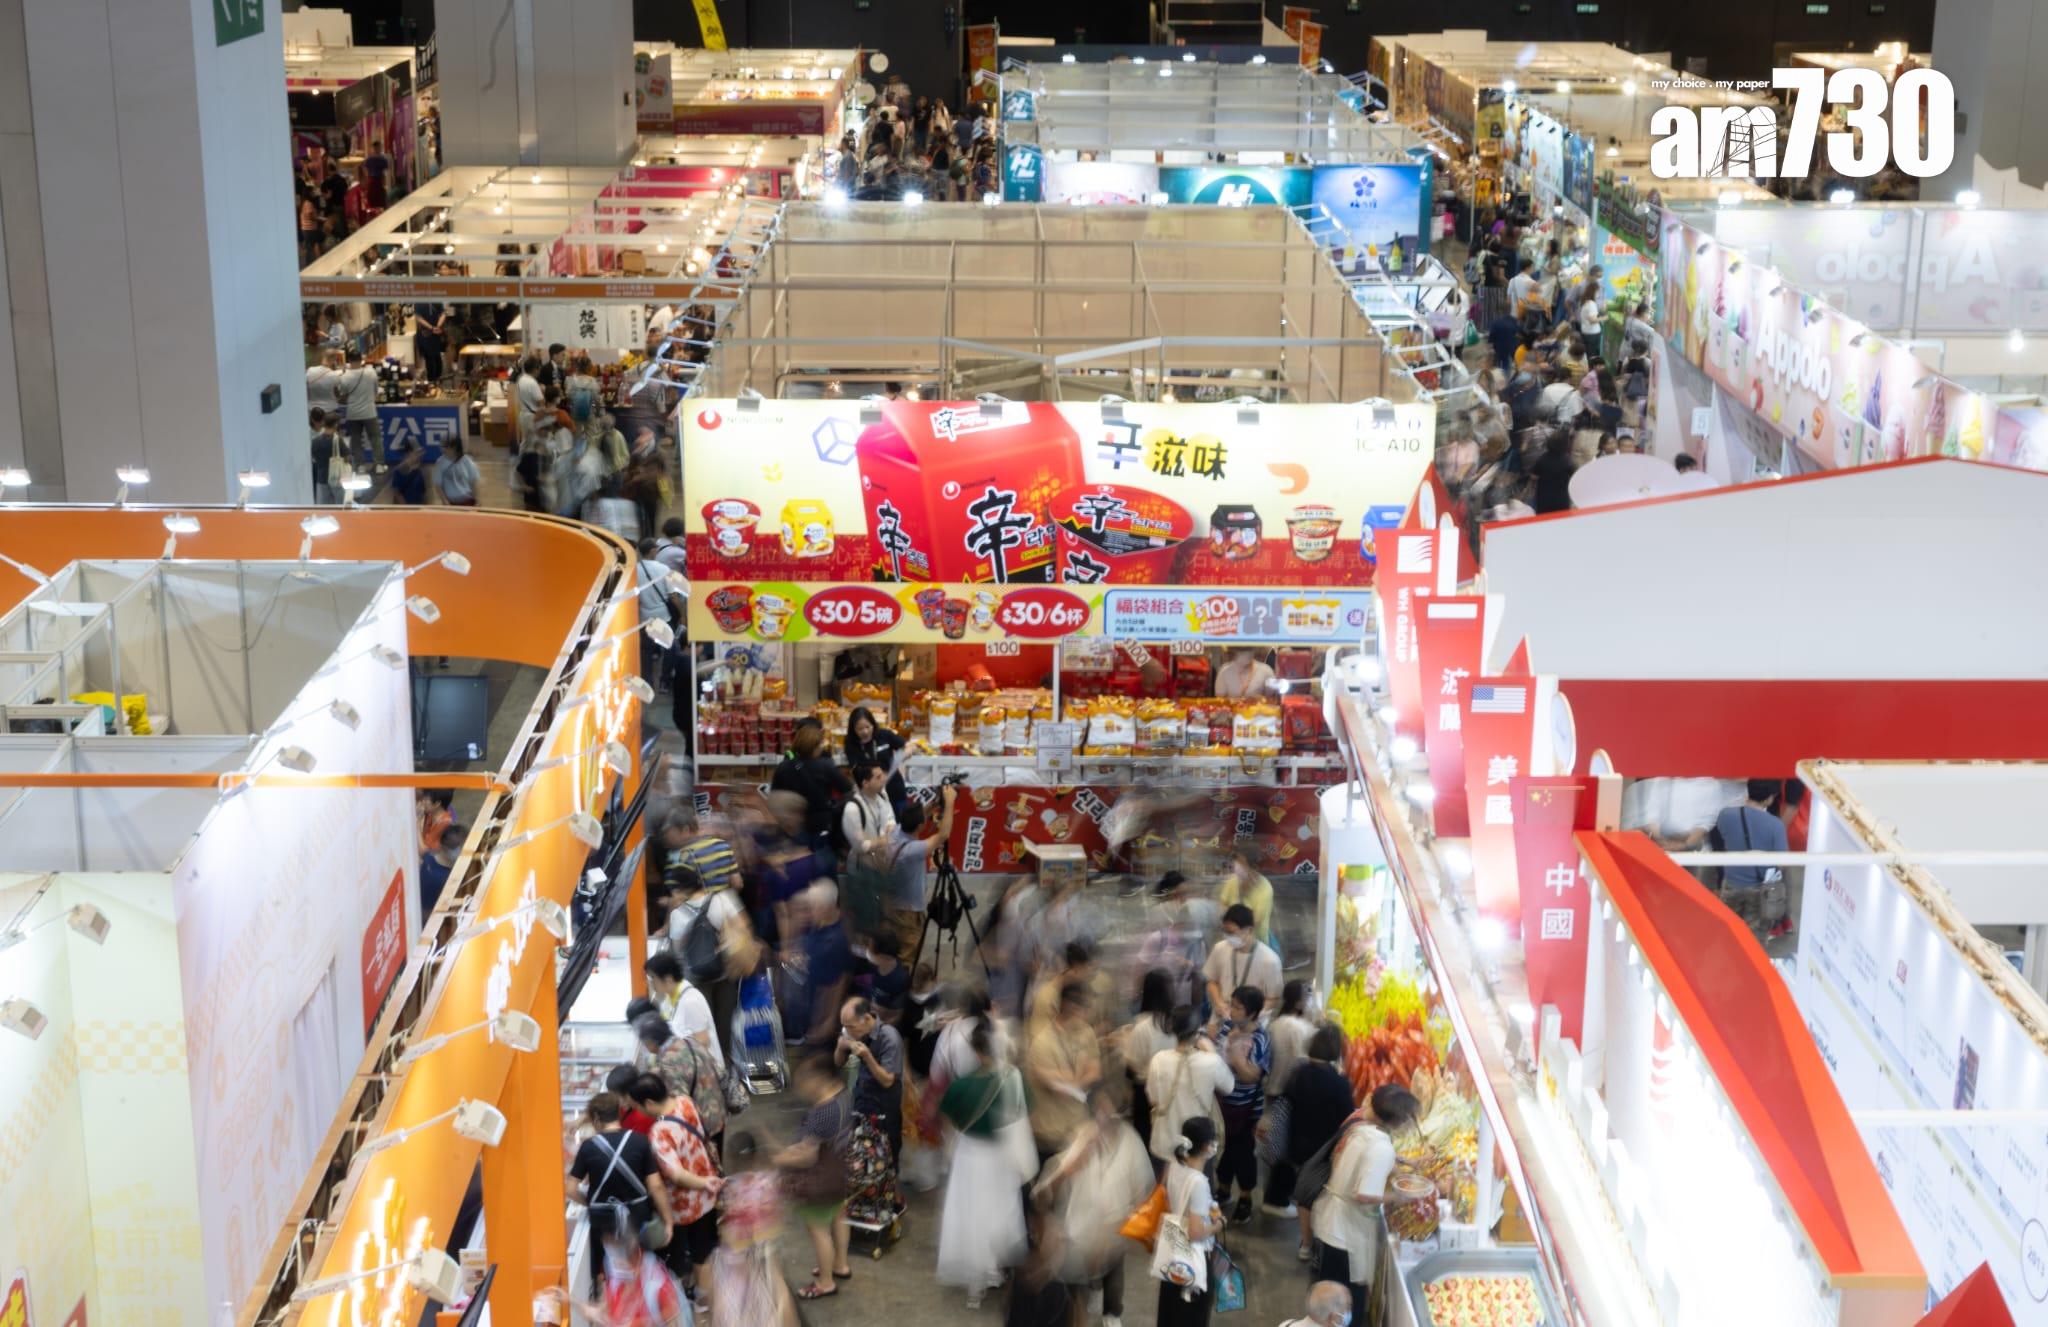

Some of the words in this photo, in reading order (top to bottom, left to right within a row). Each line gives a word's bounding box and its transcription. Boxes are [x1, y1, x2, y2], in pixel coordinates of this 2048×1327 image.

[1756, 312, 1831, 401] Appolo
[967, 487, 1033, 583] 辛
[812, 600, 893, 624] $30/5碗
[1002, 602, 1083, 625] $30/6杯
[1115, 598, 1184, 614] 福袋組合
[1195, 598, 1238, 618] $100
[987, 641, 1018, 654] $100
[1171, 639, 1201, 652] $100
[1541, 862, 1575, 940] 中國
